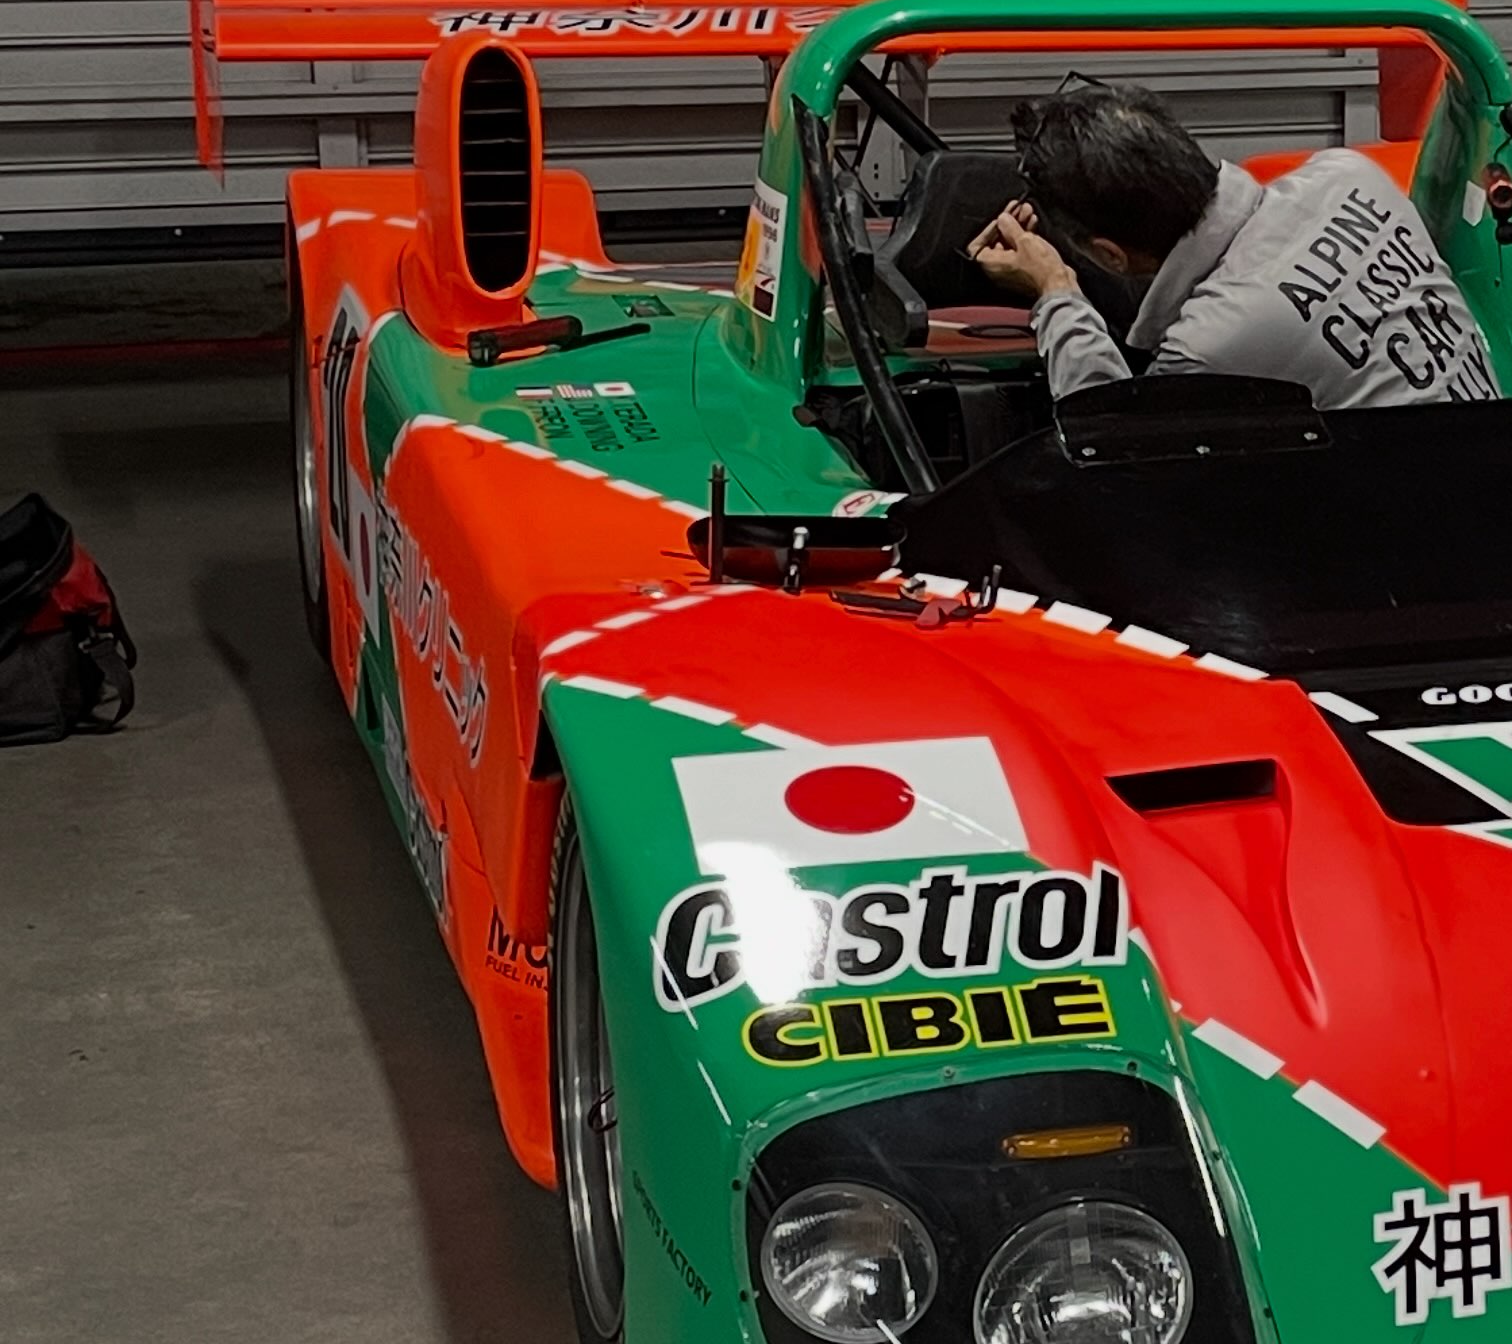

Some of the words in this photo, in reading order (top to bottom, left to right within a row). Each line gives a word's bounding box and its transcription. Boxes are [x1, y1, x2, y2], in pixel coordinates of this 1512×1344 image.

[1278, 187, 1391, 322] ALPINE
[1321, 225, 1434, 370] CLASSIC
[1385, 288, 1463, 390] CAR
[485, 954, 521, 983] FUEL
[661, 1227, 713, 1307] FACTORY
